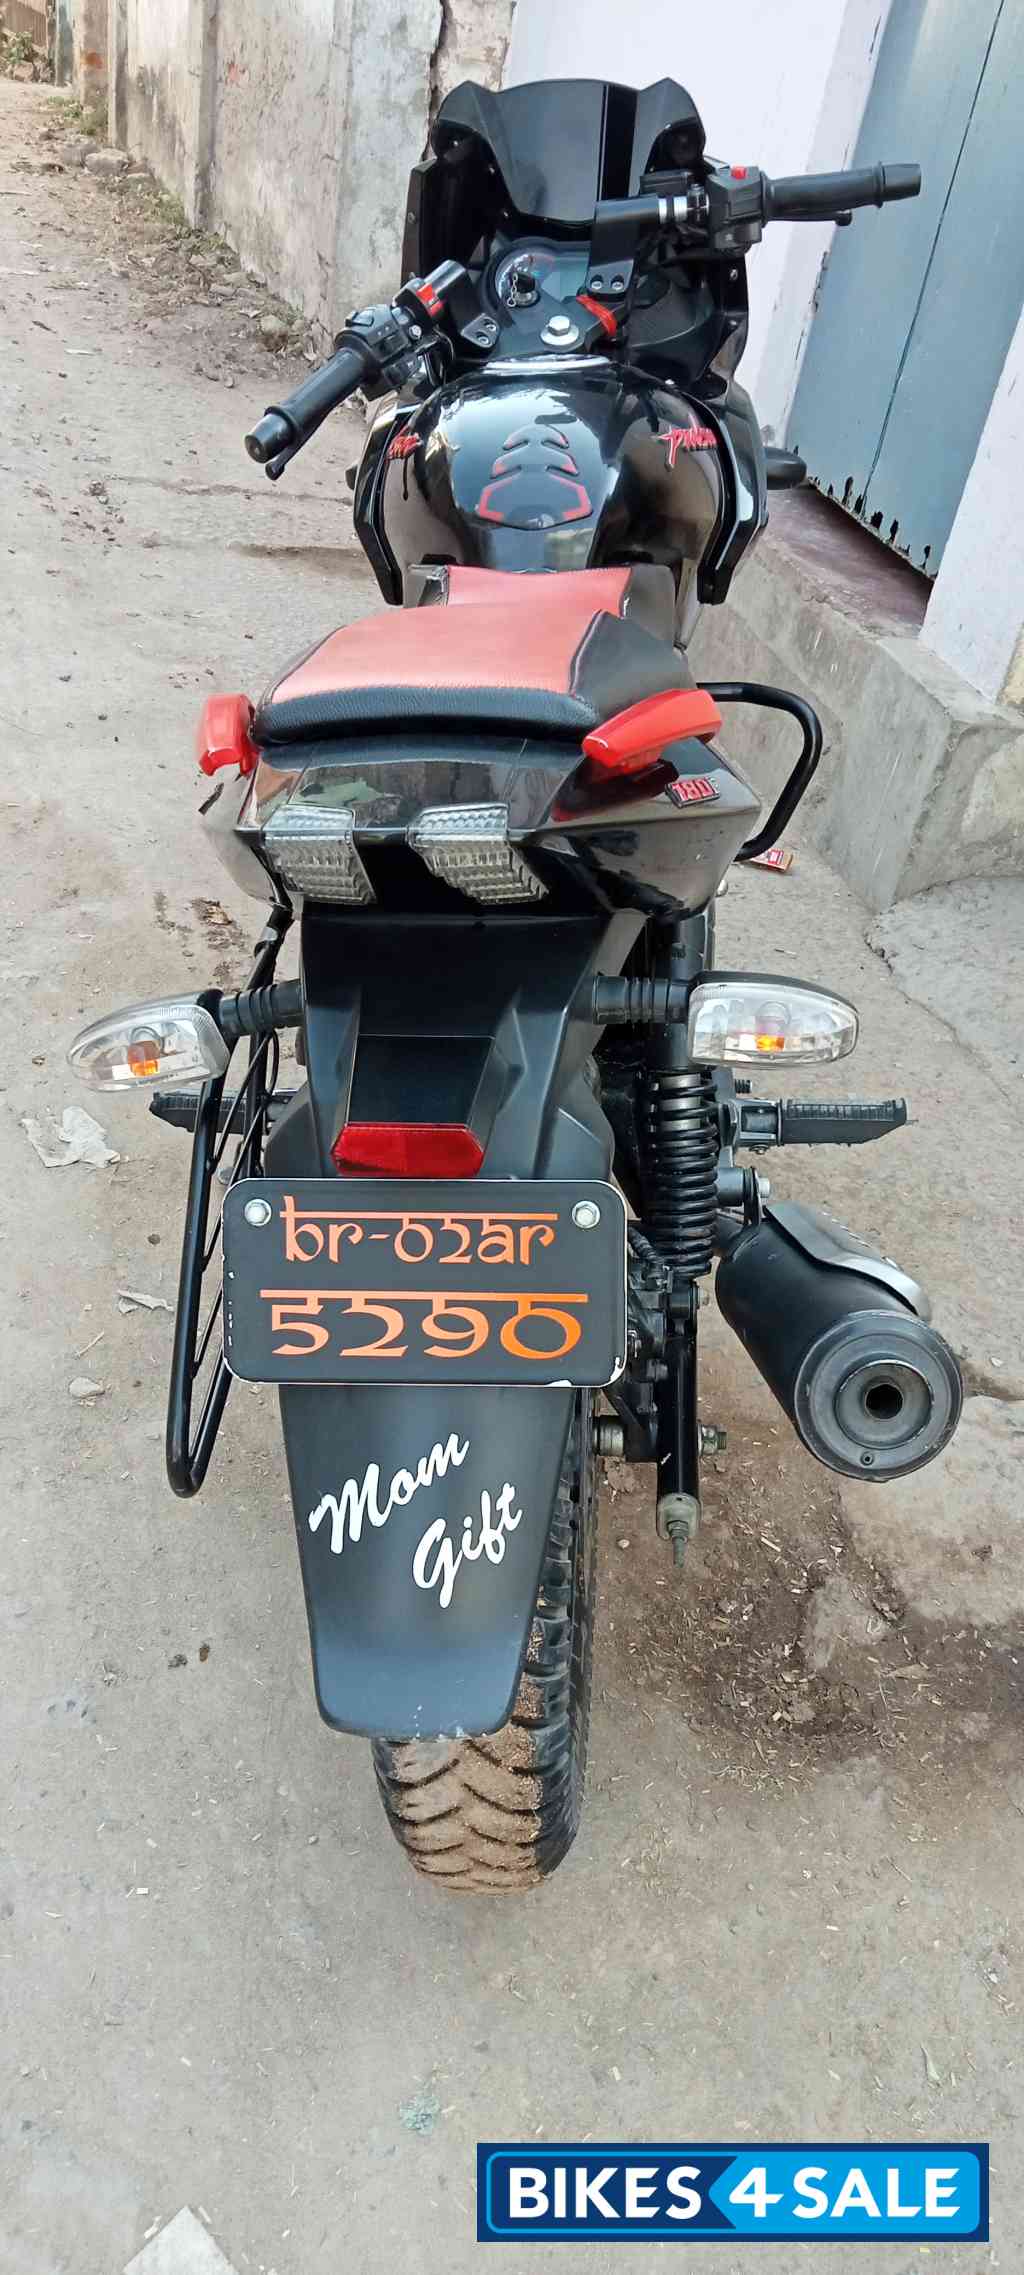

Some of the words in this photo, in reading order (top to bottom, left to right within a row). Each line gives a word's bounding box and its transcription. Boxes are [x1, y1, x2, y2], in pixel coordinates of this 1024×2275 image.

[260, 1289, 588, 1360] 5290
[308, 1433, 470, 1554] Mom
[412, 1482, 523, 1609] Gift
